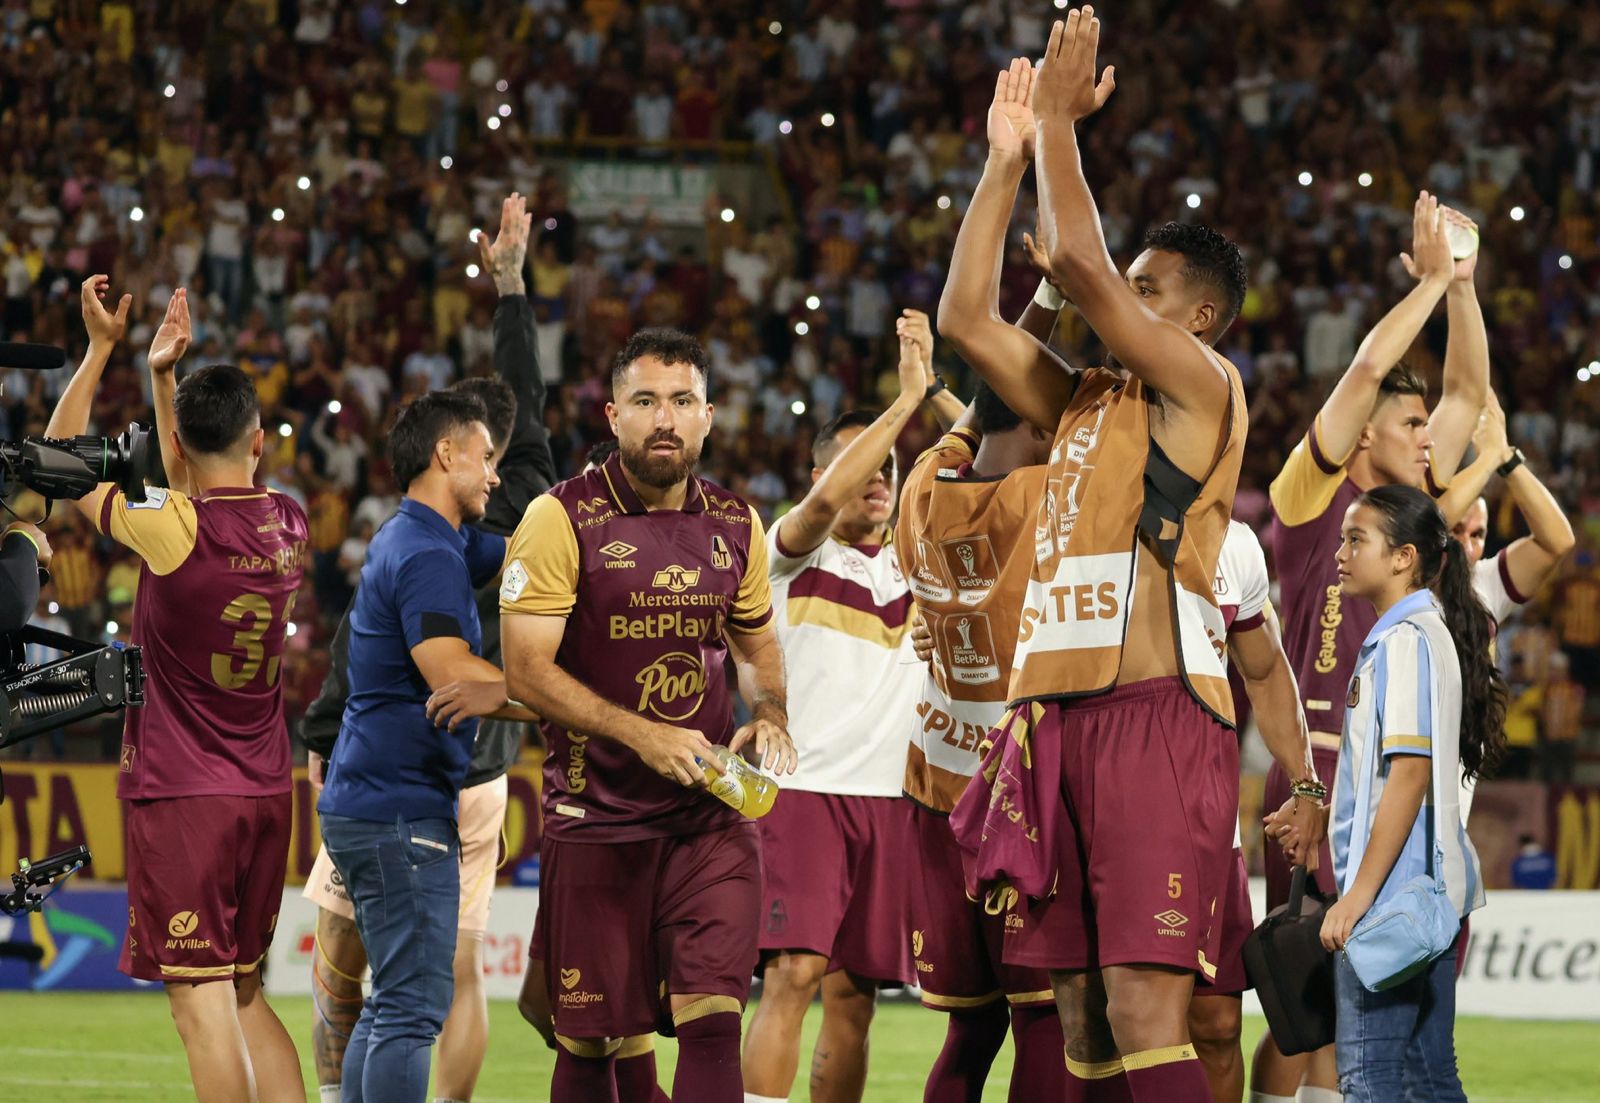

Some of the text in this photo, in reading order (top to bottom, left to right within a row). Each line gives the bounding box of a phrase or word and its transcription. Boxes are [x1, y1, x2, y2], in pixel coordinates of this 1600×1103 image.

[228, 556, 272, 570] TAPA
[605, 560, 636, 569] umbro
[628, 592, 726, 608] Mercacentro
[609, 610, 711, 642] BetPlay
[954, 654, 989, 665] BetPlay
[635, 664, 707, 712] Pool
[1167, 872, 1182, 899] 5
[1157, 928, 1186, 937] umbro
[165, 938, 211, 950] AV Villas
